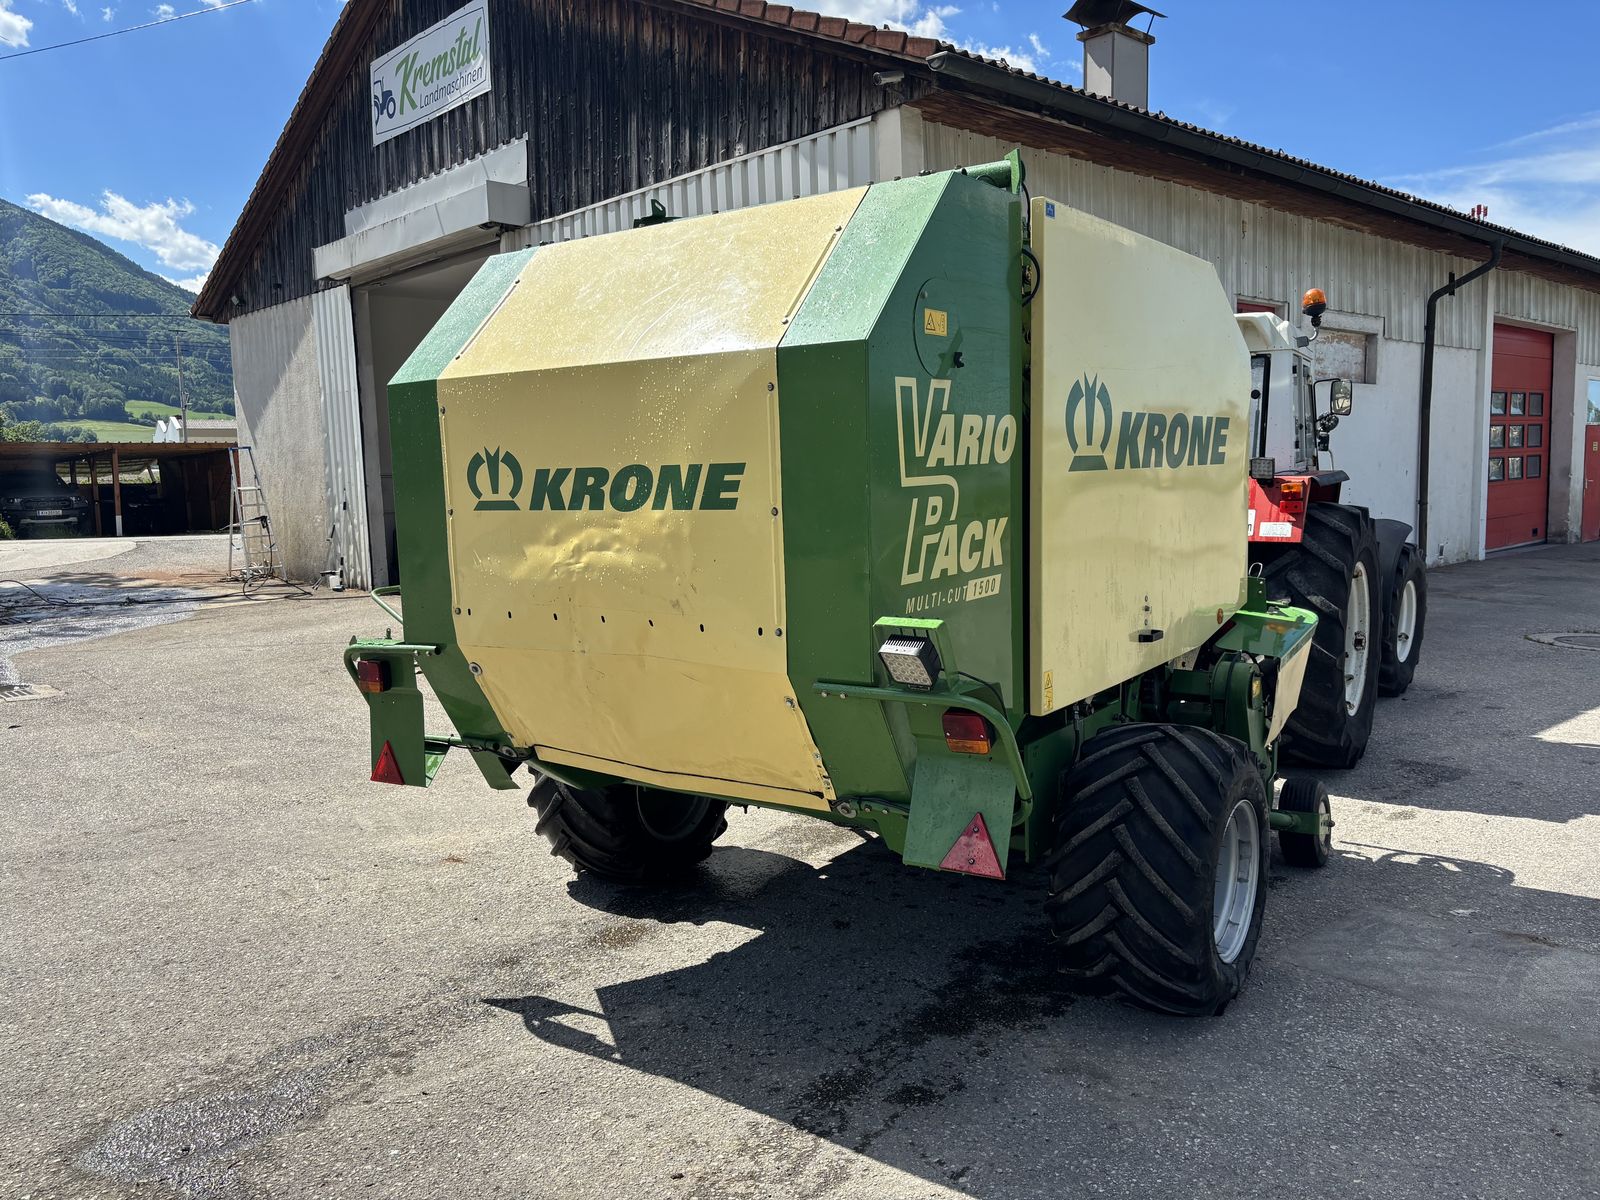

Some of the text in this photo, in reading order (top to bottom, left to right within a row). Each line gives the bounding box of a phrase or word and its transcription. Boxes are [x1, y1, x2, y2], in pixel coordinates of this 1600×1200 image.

[395, 17, 482, 115] Kremstal
[419, 66, 483, 109] Landmaschinen
[894, 376, 1017, 467] VARIO
[1115, 411, 1230, 469] KRONE
[529, 462, 747, 512] KRONE
[901, 475, 1008, 585] PACK
[905, 578, 996, 614] MULTI-CUT 1500
